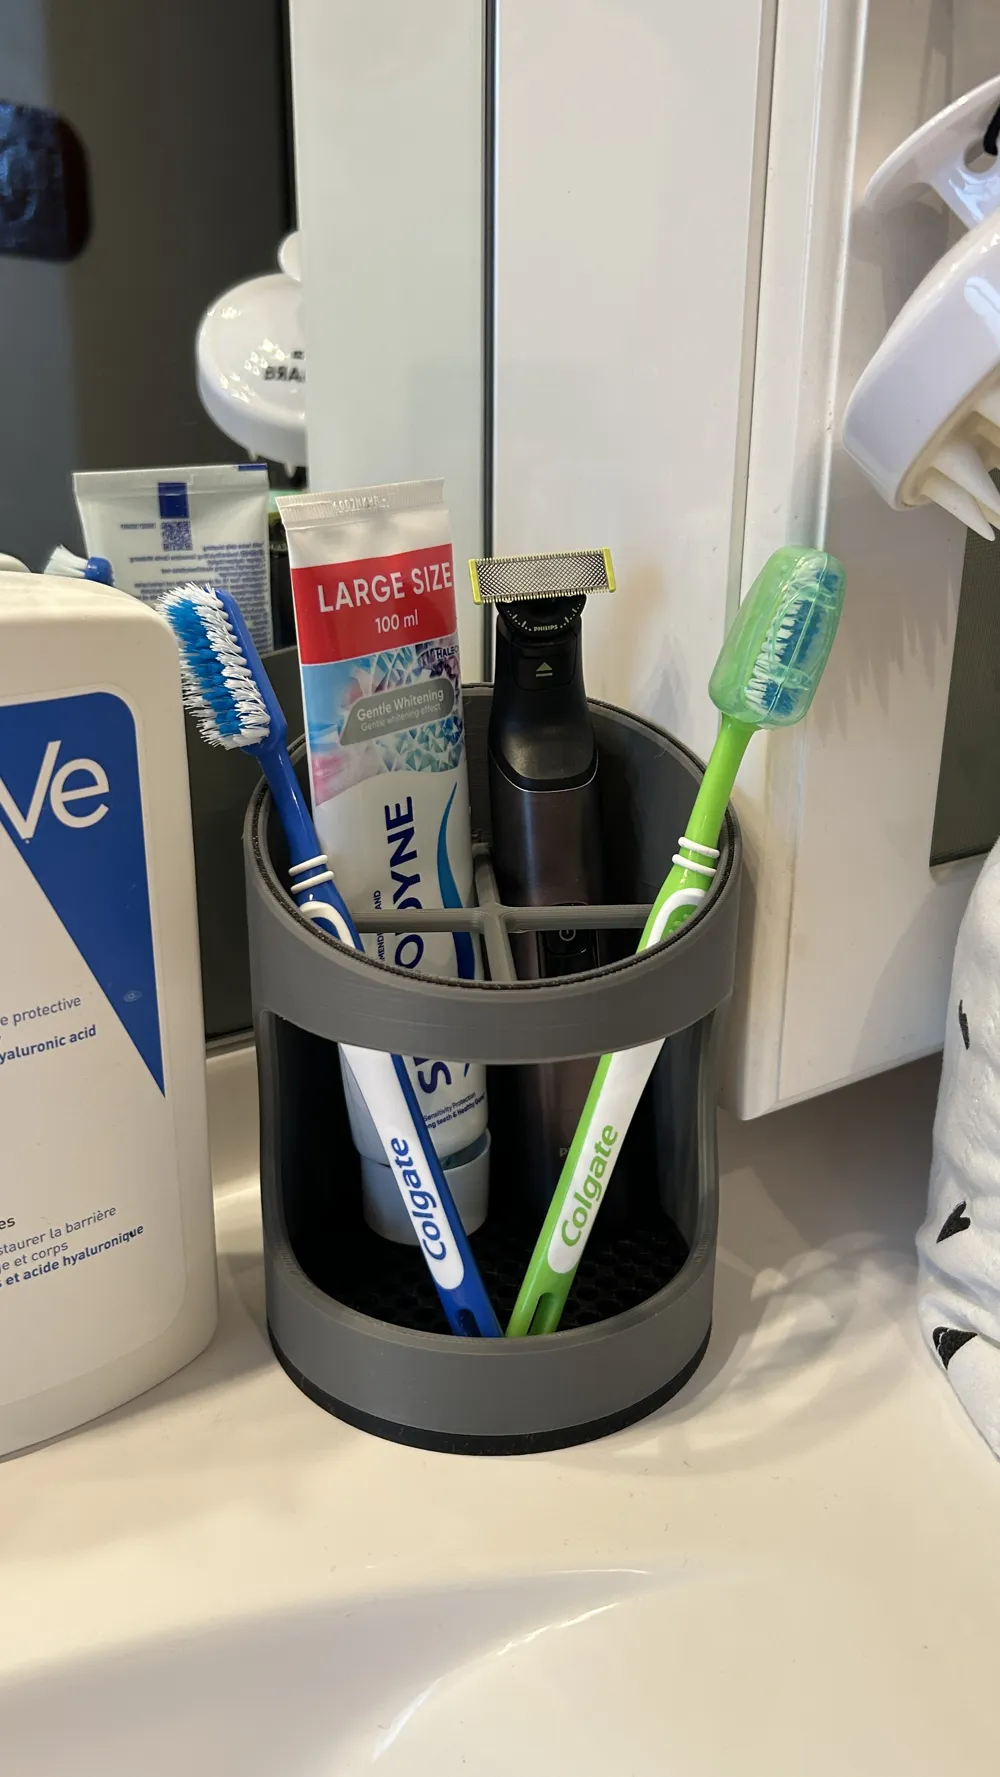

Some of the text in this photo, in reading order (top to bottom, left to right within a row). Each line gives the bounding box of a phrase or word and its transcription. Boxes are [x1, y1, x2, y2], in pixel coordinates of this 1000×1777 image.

[317, 562, 453, 613] LARGE SIZE
[375, 609, 419, 634] 100 ml
[533, 624, 558, 632] PHILIPS
[436, 645, 459, 659] HALEO
[356, 689, 444, 720] Gentle Whitening
[361, 718, 386, 732] Gentle
[387, 709, 419, 725] whitening
[13, 997, 81, 1026] protective
[69, 1024, 96, 1043] acid
[390, 1137, 447, 1261] Colgate
[561, 1124, 618, 1247] Colgate
[49, 1228, 62, 1239] la
[65, 1206, 117, 1233] barrière
[6, 1273, 20, 1285] et
[23, 1261, 59, 1280] acide
[63, 1224, 145, 1266] hyaluronique
[14, 1254, 27, 1267] et
[31, 1242, 69, 1261] corps
